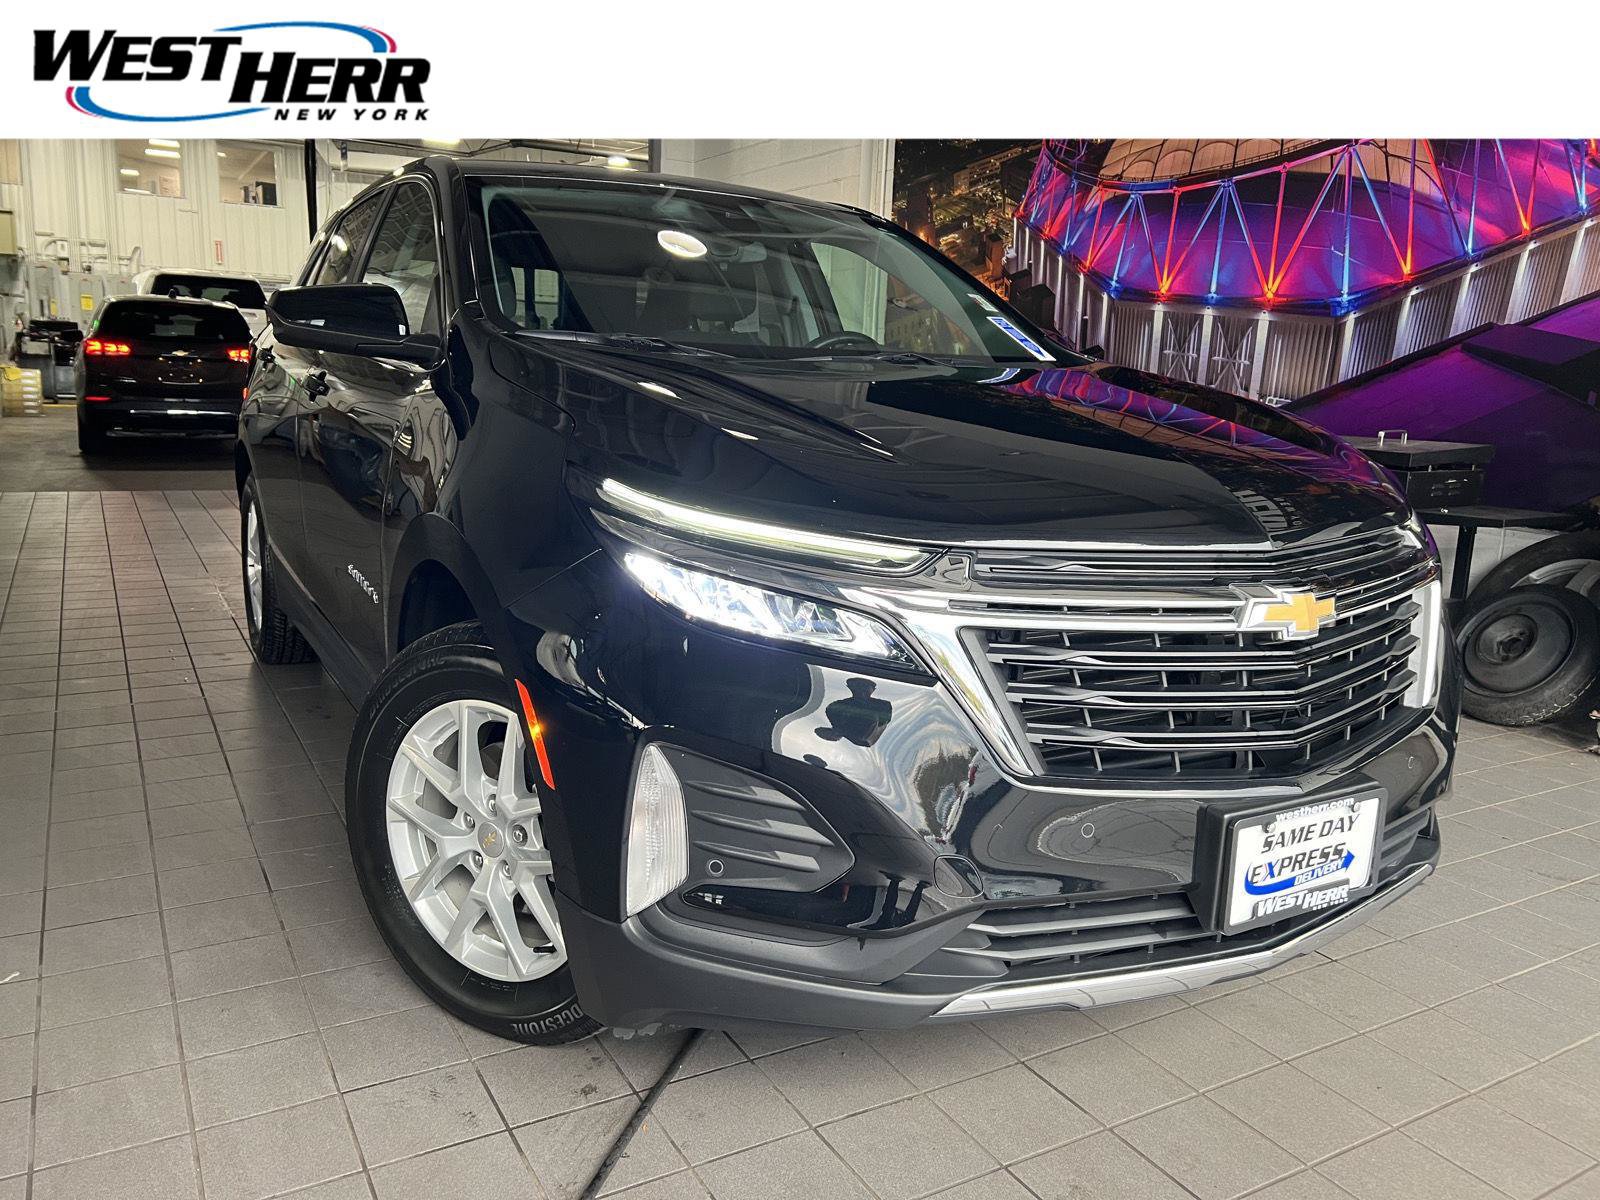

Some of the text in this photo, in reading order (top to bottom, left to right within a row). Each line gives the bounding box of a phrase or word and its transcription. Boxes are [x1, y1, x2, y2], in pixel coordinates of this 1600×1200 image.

[1275, 798, 1355, 822] westherr.com
[1261, 813, 1360, 854] SAME DAY
[1251, 842, 1347, 885] EXPRESS
[1294, 857, 1346, 886] DELIVERY
